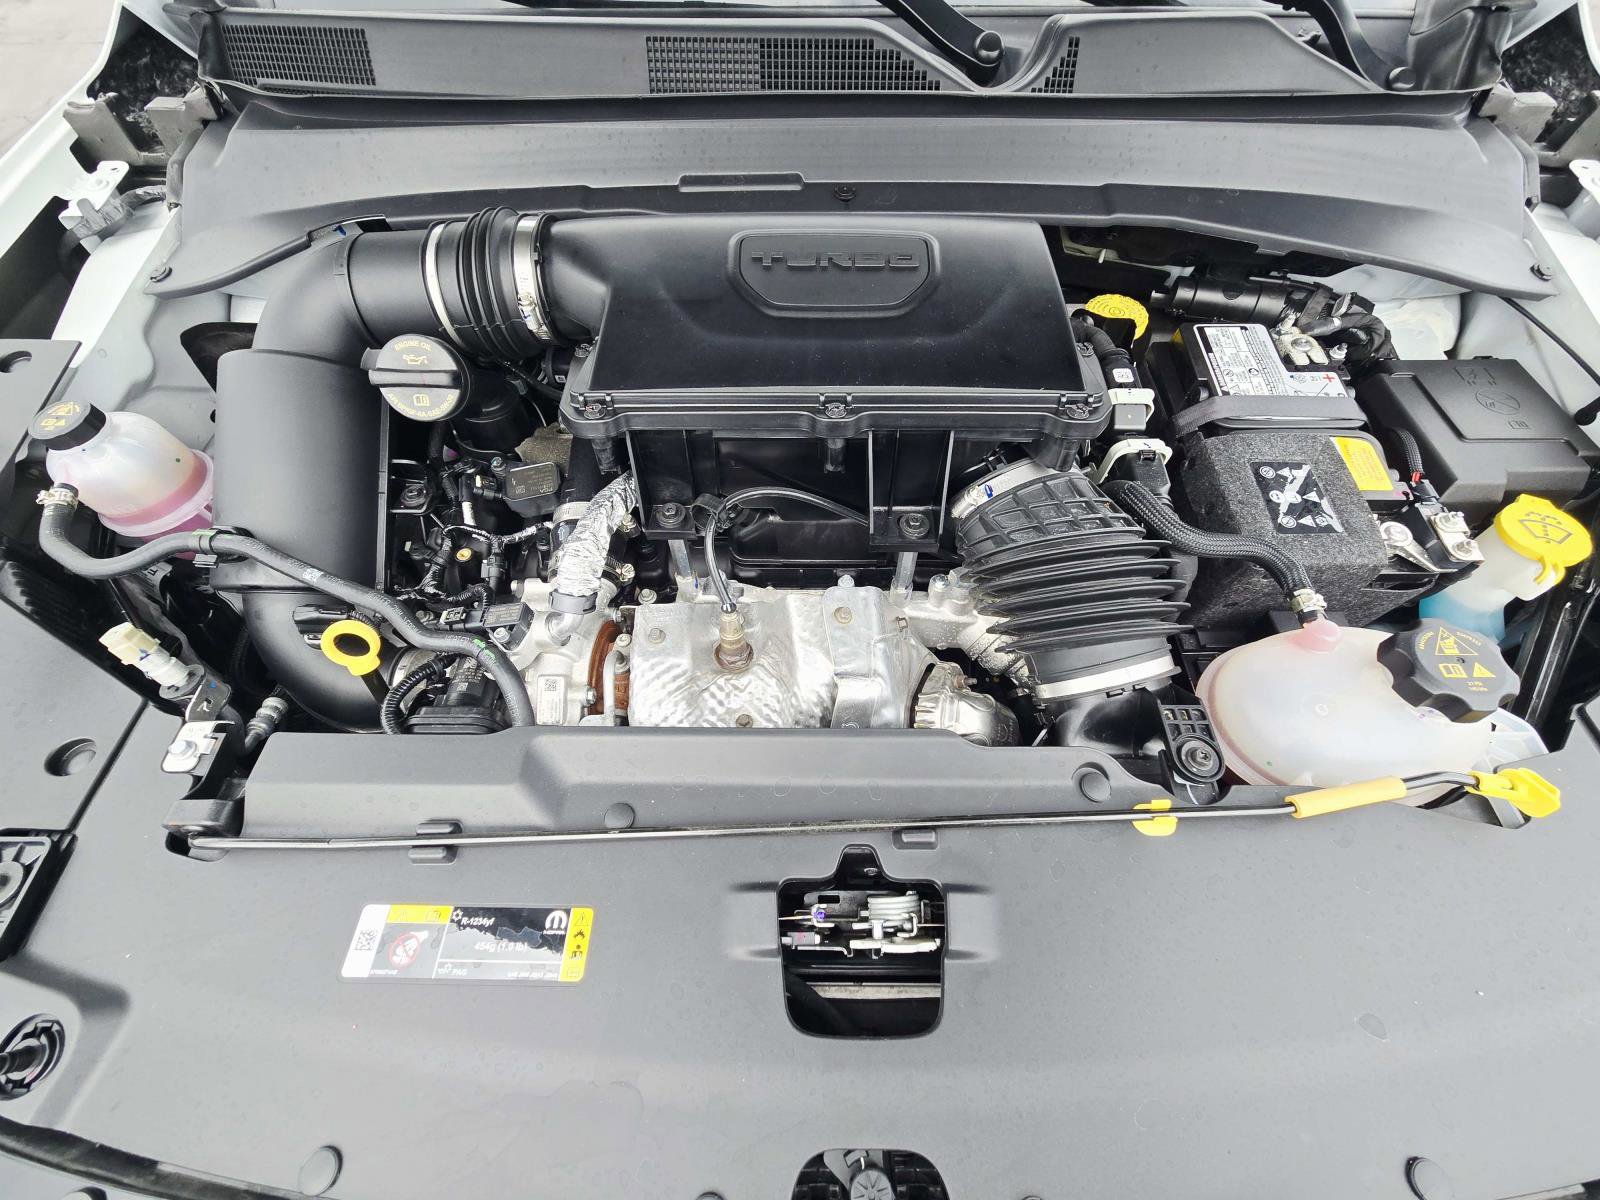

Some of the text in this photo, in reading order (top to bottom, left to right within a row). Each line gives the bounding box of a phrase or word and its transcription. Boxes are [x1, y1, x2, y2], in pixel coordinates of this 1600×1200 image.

[751, 251, 920, 269] TURBO
[394, 339, 433, 352] ENGINE OIL
[474, 942, 496, 952] 454g
